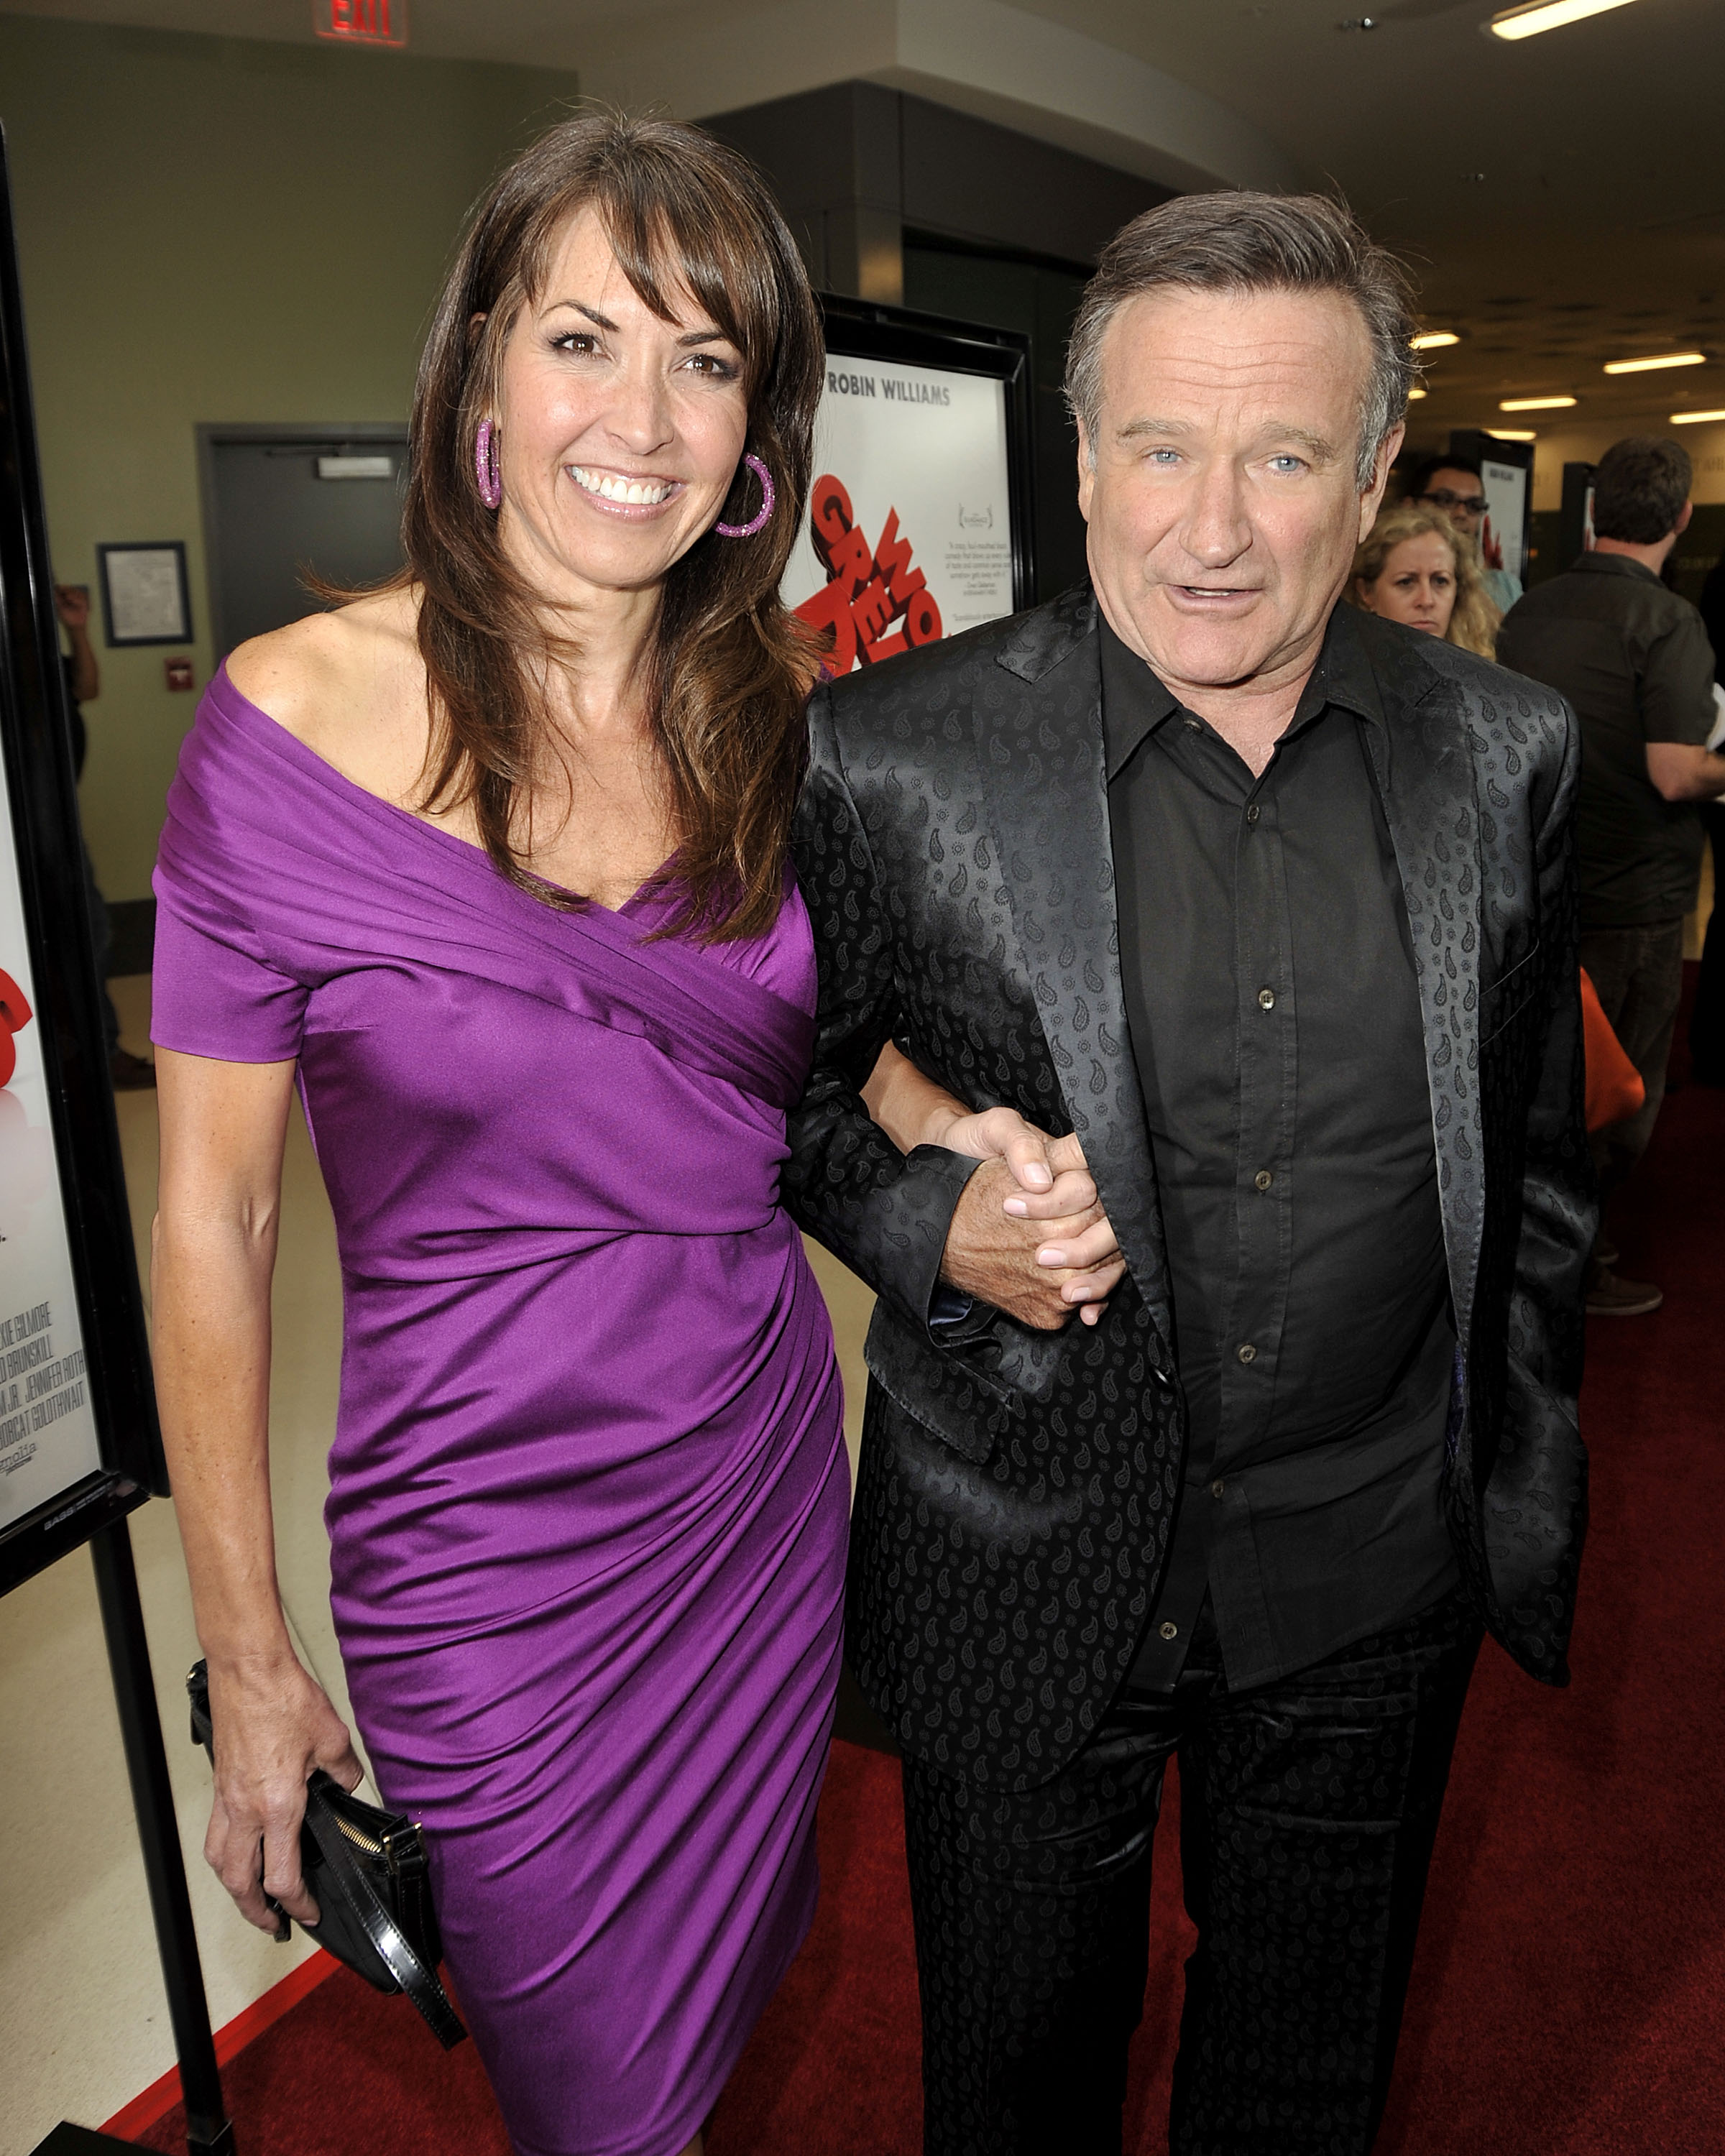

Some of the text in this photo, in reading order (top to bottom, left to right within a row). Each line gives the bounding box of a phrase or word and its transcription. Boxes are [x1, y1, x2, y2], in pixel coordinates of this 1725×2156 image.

[827, 371, 950, 405] ROBIN WILLIAMS
[14, 1300, 52, 1342] GILMORE
[6, 1333, 54, 1380] BRUNSKILL
[24, 1360, 64, 1404] JENNIFER
[62, 1348, 86, 1383] ROTH
[30, 1380, 84, 1432] GOLDTHWAIT
[44, 1506, 75, 1531] BASS
